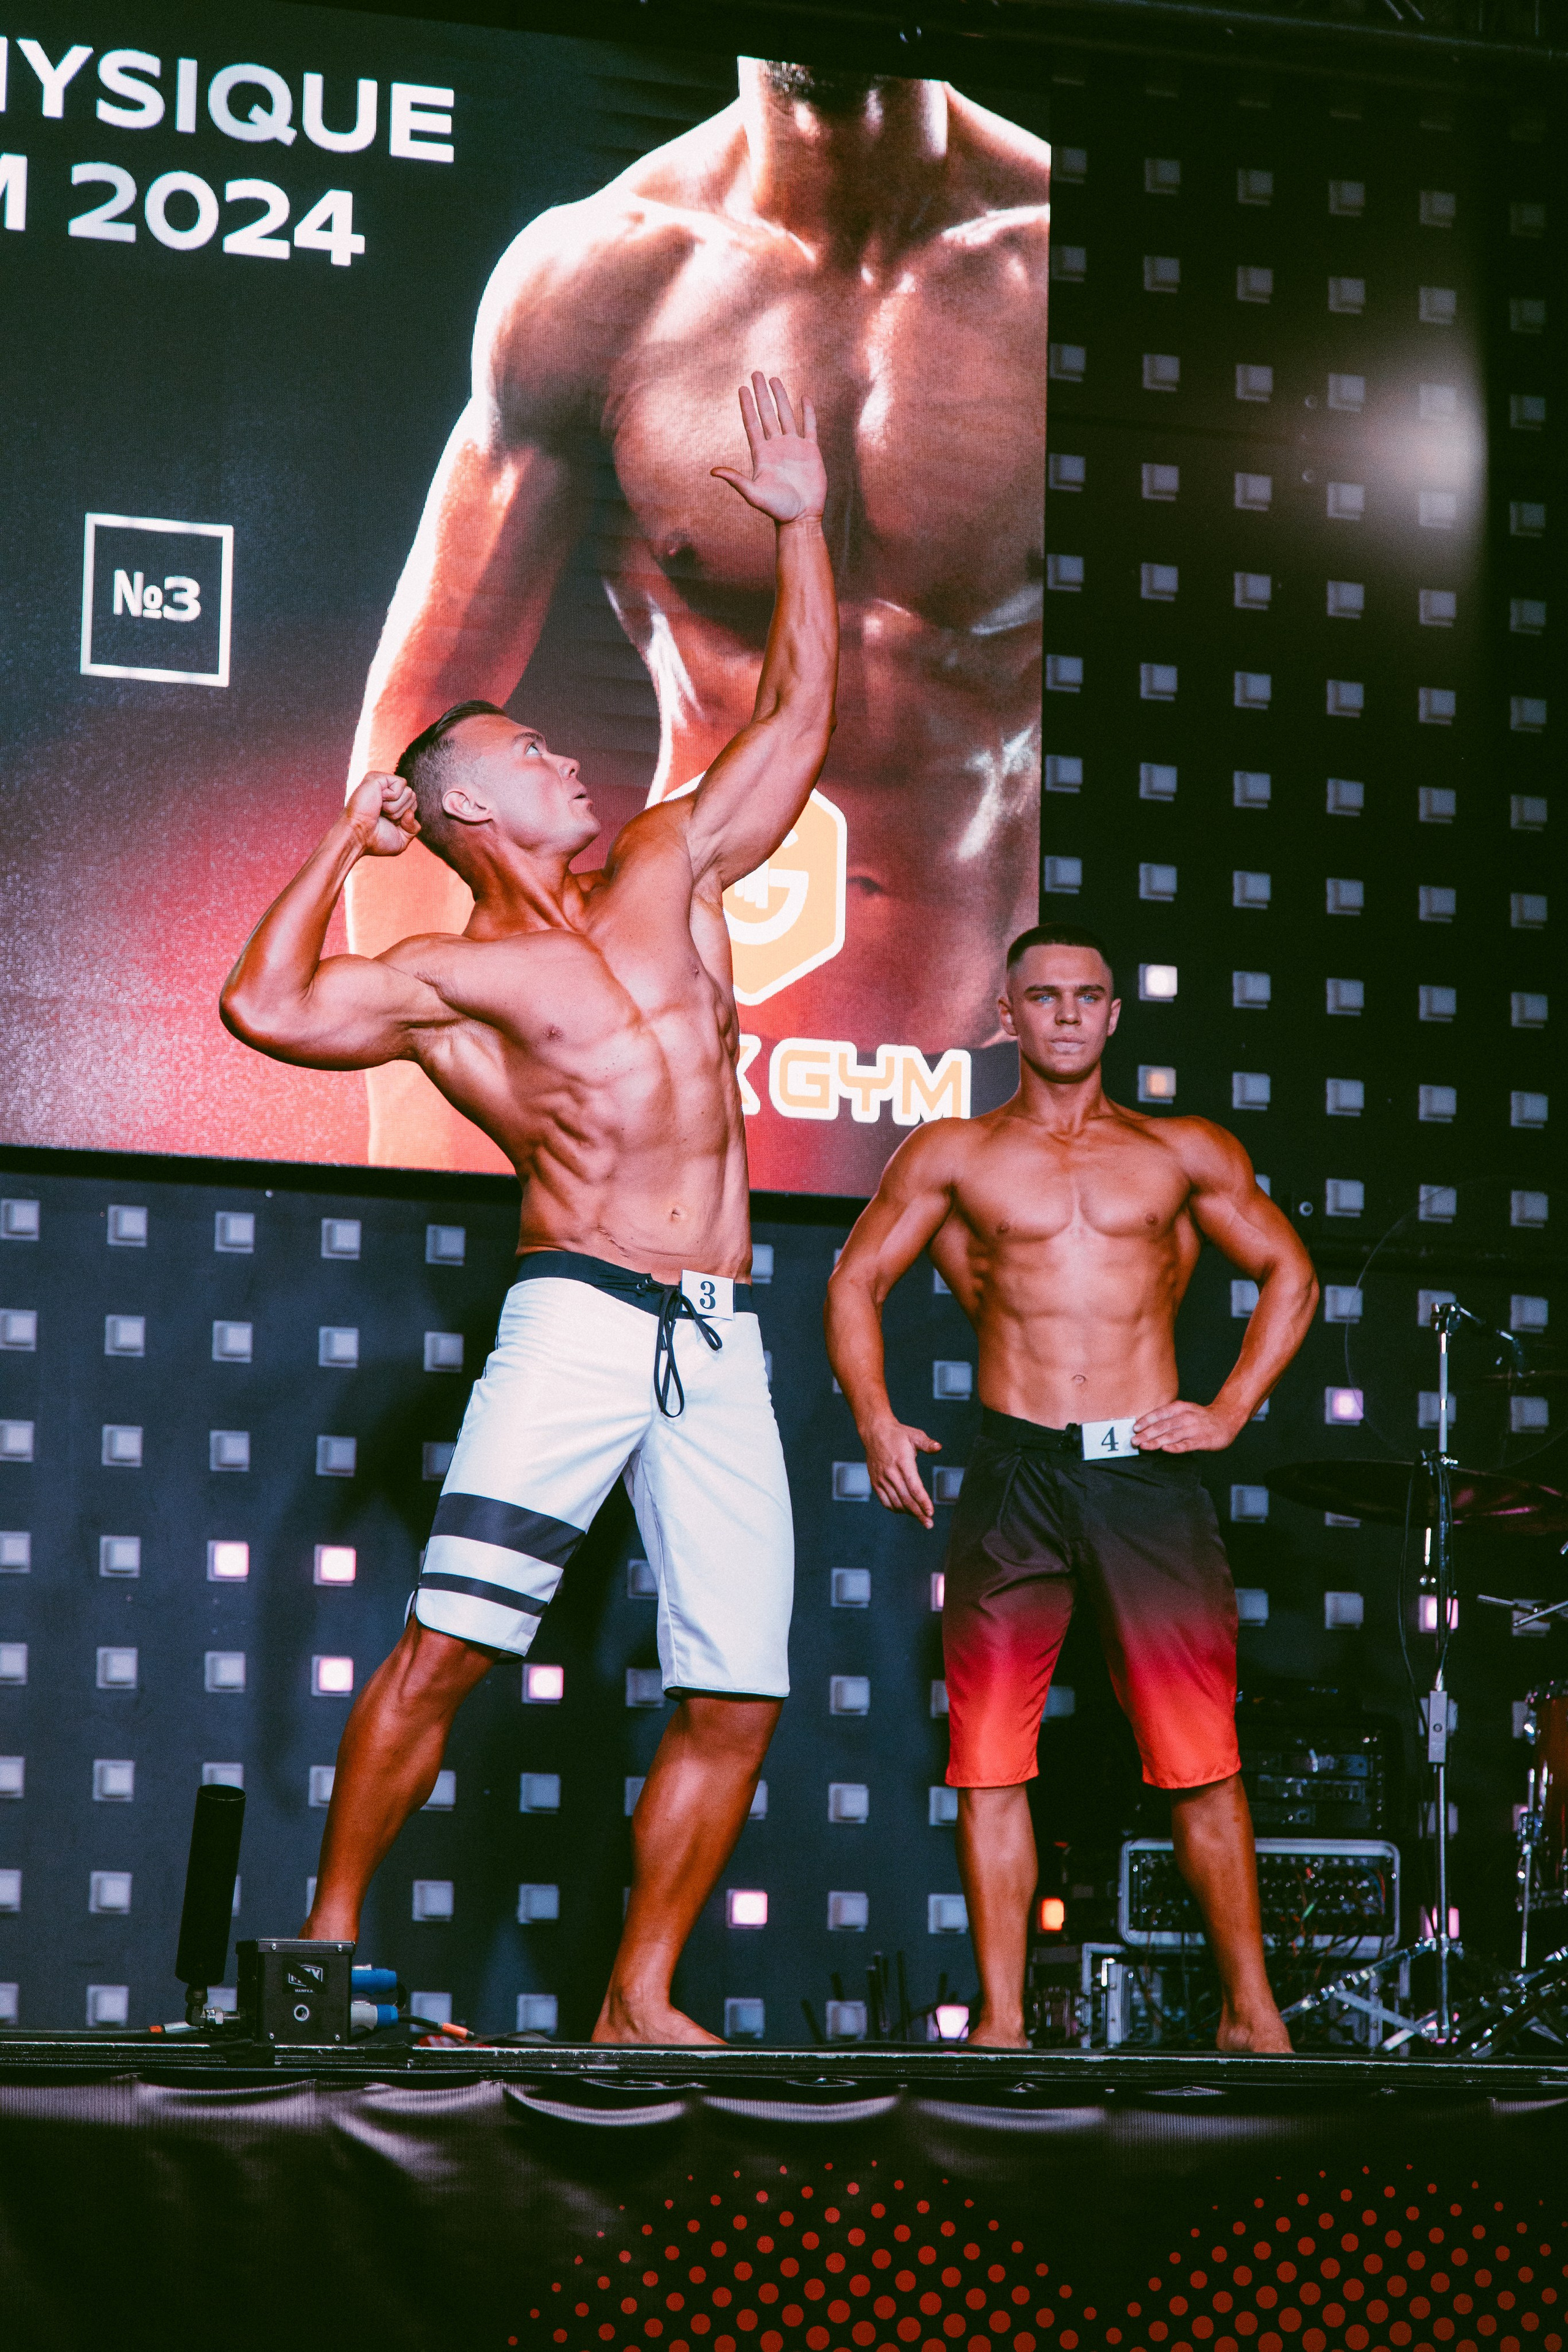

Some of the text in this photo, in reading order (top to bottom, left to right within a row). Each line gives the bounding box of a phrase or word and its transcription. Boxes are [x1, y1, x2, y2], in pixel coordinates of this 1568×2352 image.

[0, 36, 454, 164] YSIQUE
[68, 161, 366, 267] 2024
[769, 1038, 971, 1126] GYM
[699, 1281, 716, 1310] 3
[1101, 1427, 1119, 1452] 4
